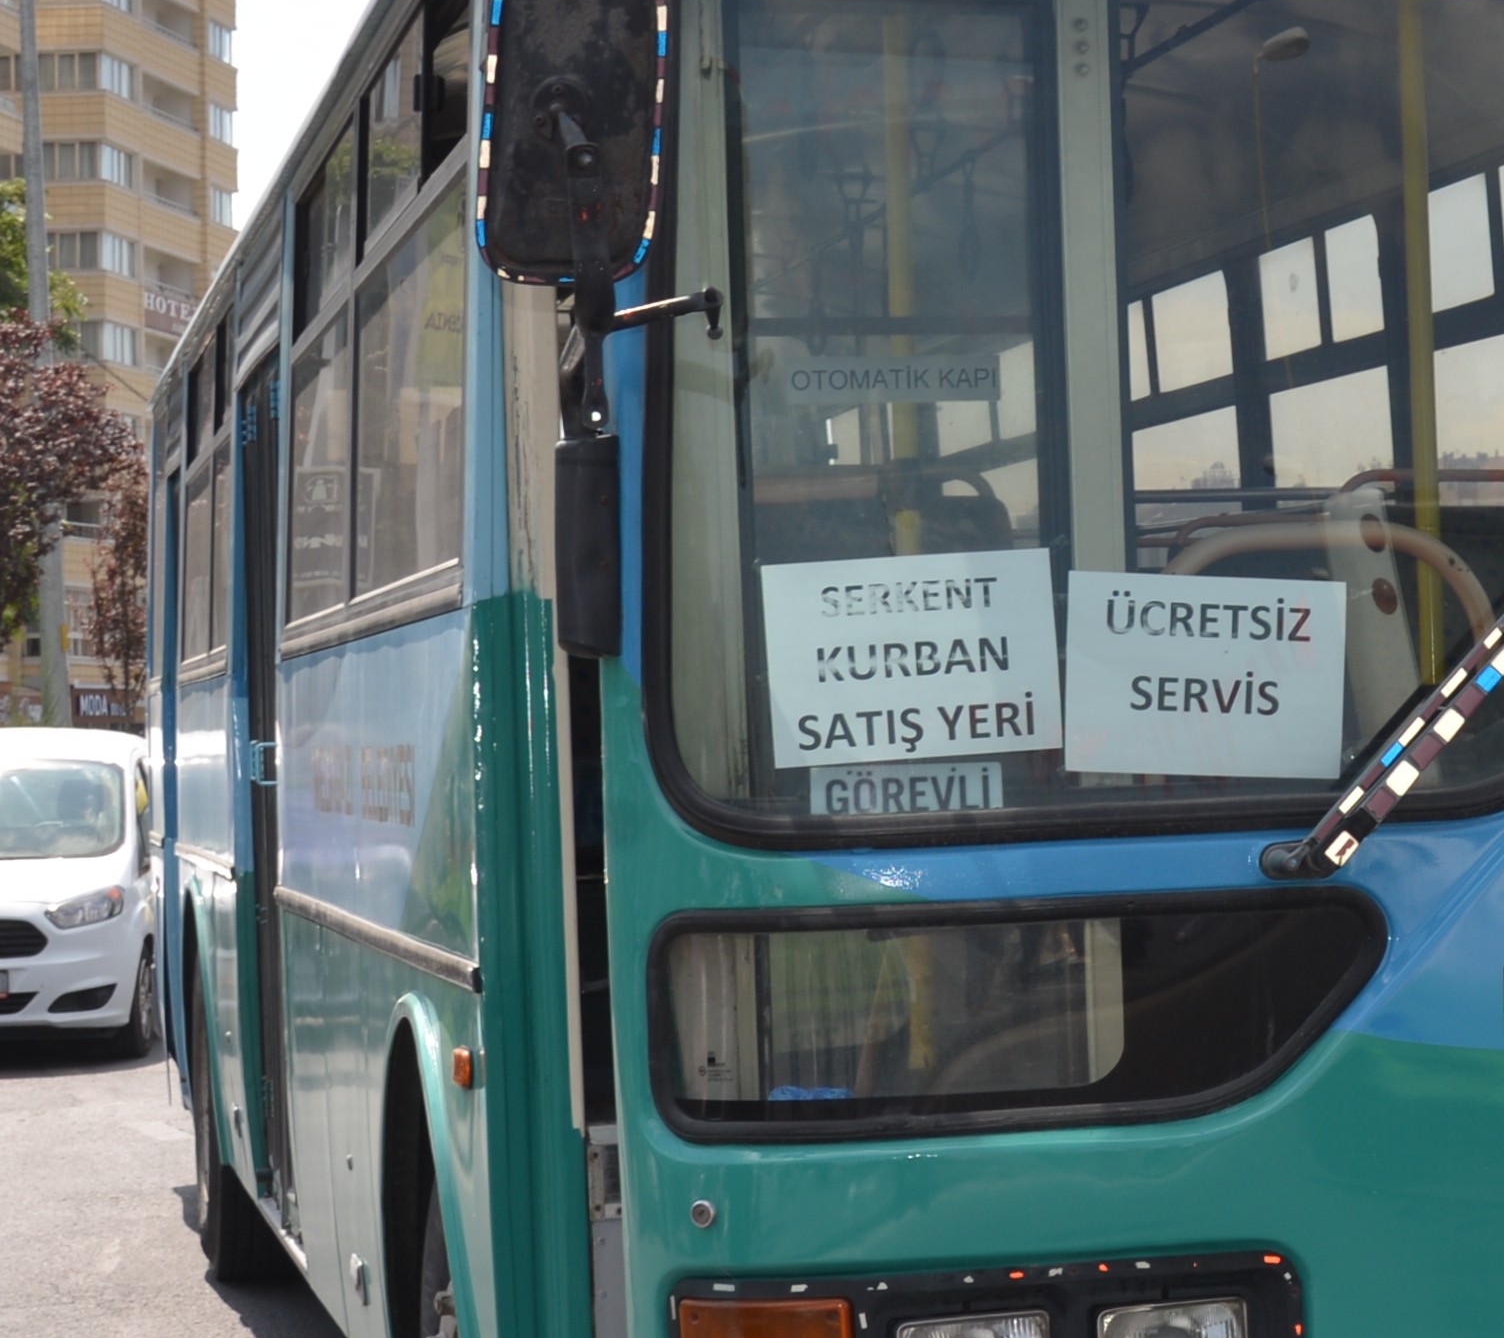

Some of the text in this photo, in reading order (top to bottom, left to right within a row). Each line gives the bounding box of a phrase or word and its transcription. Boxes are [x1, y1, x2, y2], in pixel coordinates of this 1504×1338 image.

[144, 292, 197, 321] HOTE
[791, 366, 996, 391] OTOMATİK KAPI
[821, 577, 997, 618] SERKENT
[1107, 590, 1311, 642] ÜCRETSİZ
[817, 636, 1009, 682] KURBAN
[79, 694, 108, 717] MODA
[1130, 671, 1279, 715] SERVİS
[798, 691, 1034, 753] SATIŞ YERİ
[825, 767, 989, 812] GÖREVLİ
